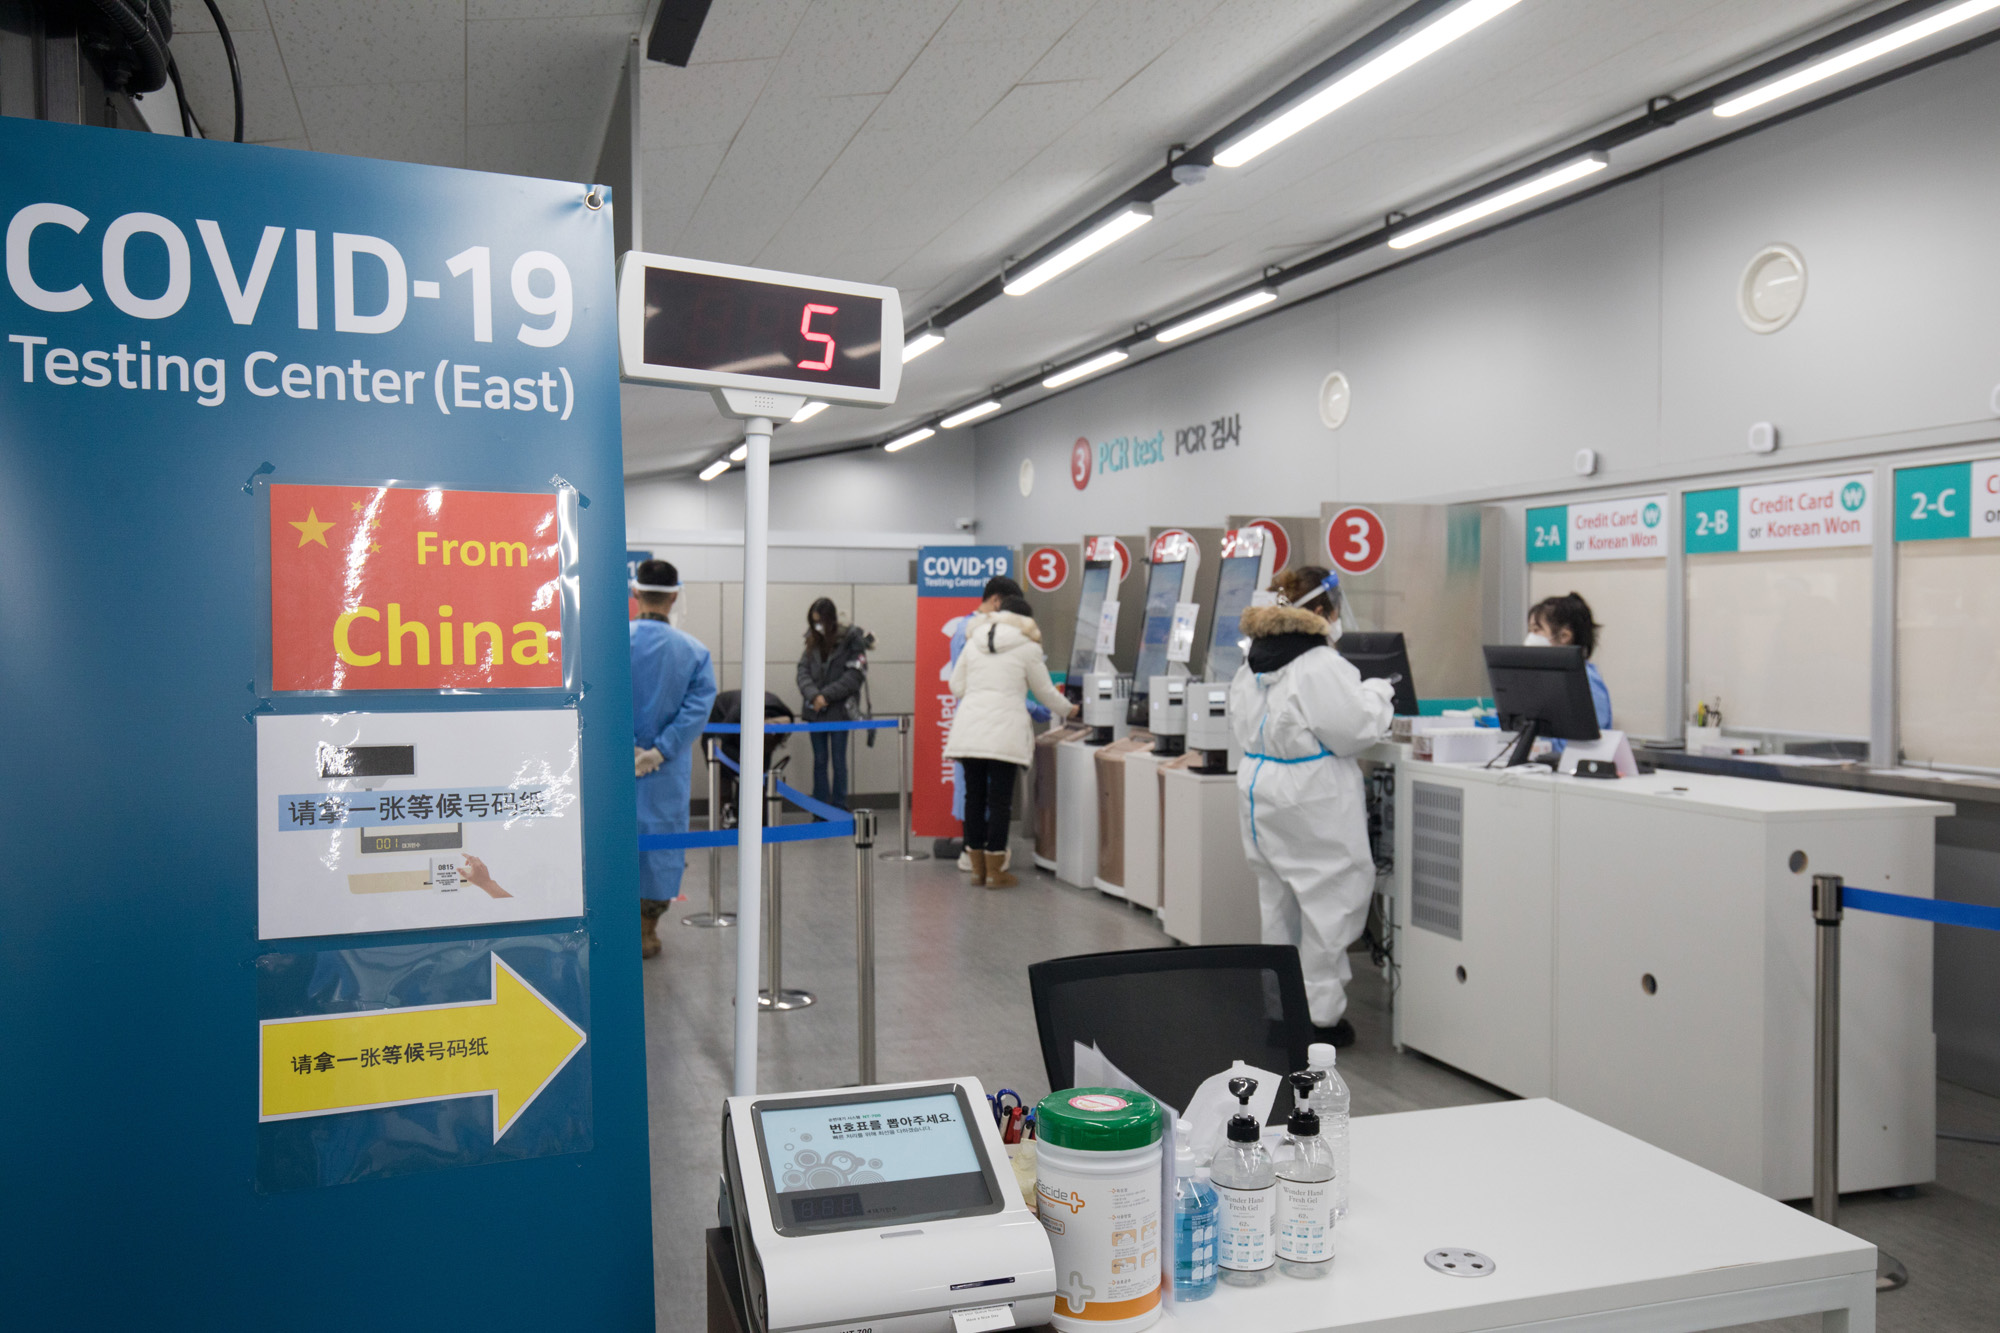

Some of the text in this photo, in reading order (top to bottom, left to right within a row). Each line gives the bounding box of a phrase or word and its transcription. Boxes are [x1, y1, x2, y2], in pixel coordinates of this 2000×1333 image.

[5, 202, 574, 348] COVID-19
[797, 303, 839, 371] 5
[9, 334, 575, 421] Testing Center (East)
[1175, 413, 1242, 457] PCR 검사
[1075, 429, 1165, 482] 3 PCR test
[1750, 495, 1793, 515] Credit
[1798, 491, 1834, 511] Card
[1910, 488, 1957, 520] 2-C
[1575, 512, 1609, 530] Credit
[1611, 509, 1638, 528] Card
[1695, 509, 1729, 536] 2-B
[1748, 517, 1861, 539] or Korean Won
[1343, 516, 1371, 562] 3
[1534, 525, 1561, 548] 2-A
[1575, 533, 1658, 551] or Korean Won
[416, 531, 529, 567] From
[923, 556, 1008, 577] COVID-19
[1037, 553, 1058, 584] 3
[924, 577, 953, 589] Testing
[954, 577, 982, 588] Center
[332, 602, 551, 668] China
[288, 790, 546, 827] 请拿一张等候号码纸
[376, 837, 398, 850] 001
[437, 863, 454, 871] 0815
[290, 1036, 490, 1076] 请拿一张等候号码纸
[829, 1112, 957, 1135] 번호표를 뽑아주세요.
[1223, 1194, 1265, 1204] Wonder Hand
[1283, 1186, 1324, 1197] Wonder Hand
[1288, 1195, 1306, 1204] Fresh
[1229, 1203, 1259, 1212] Fresh Gel
